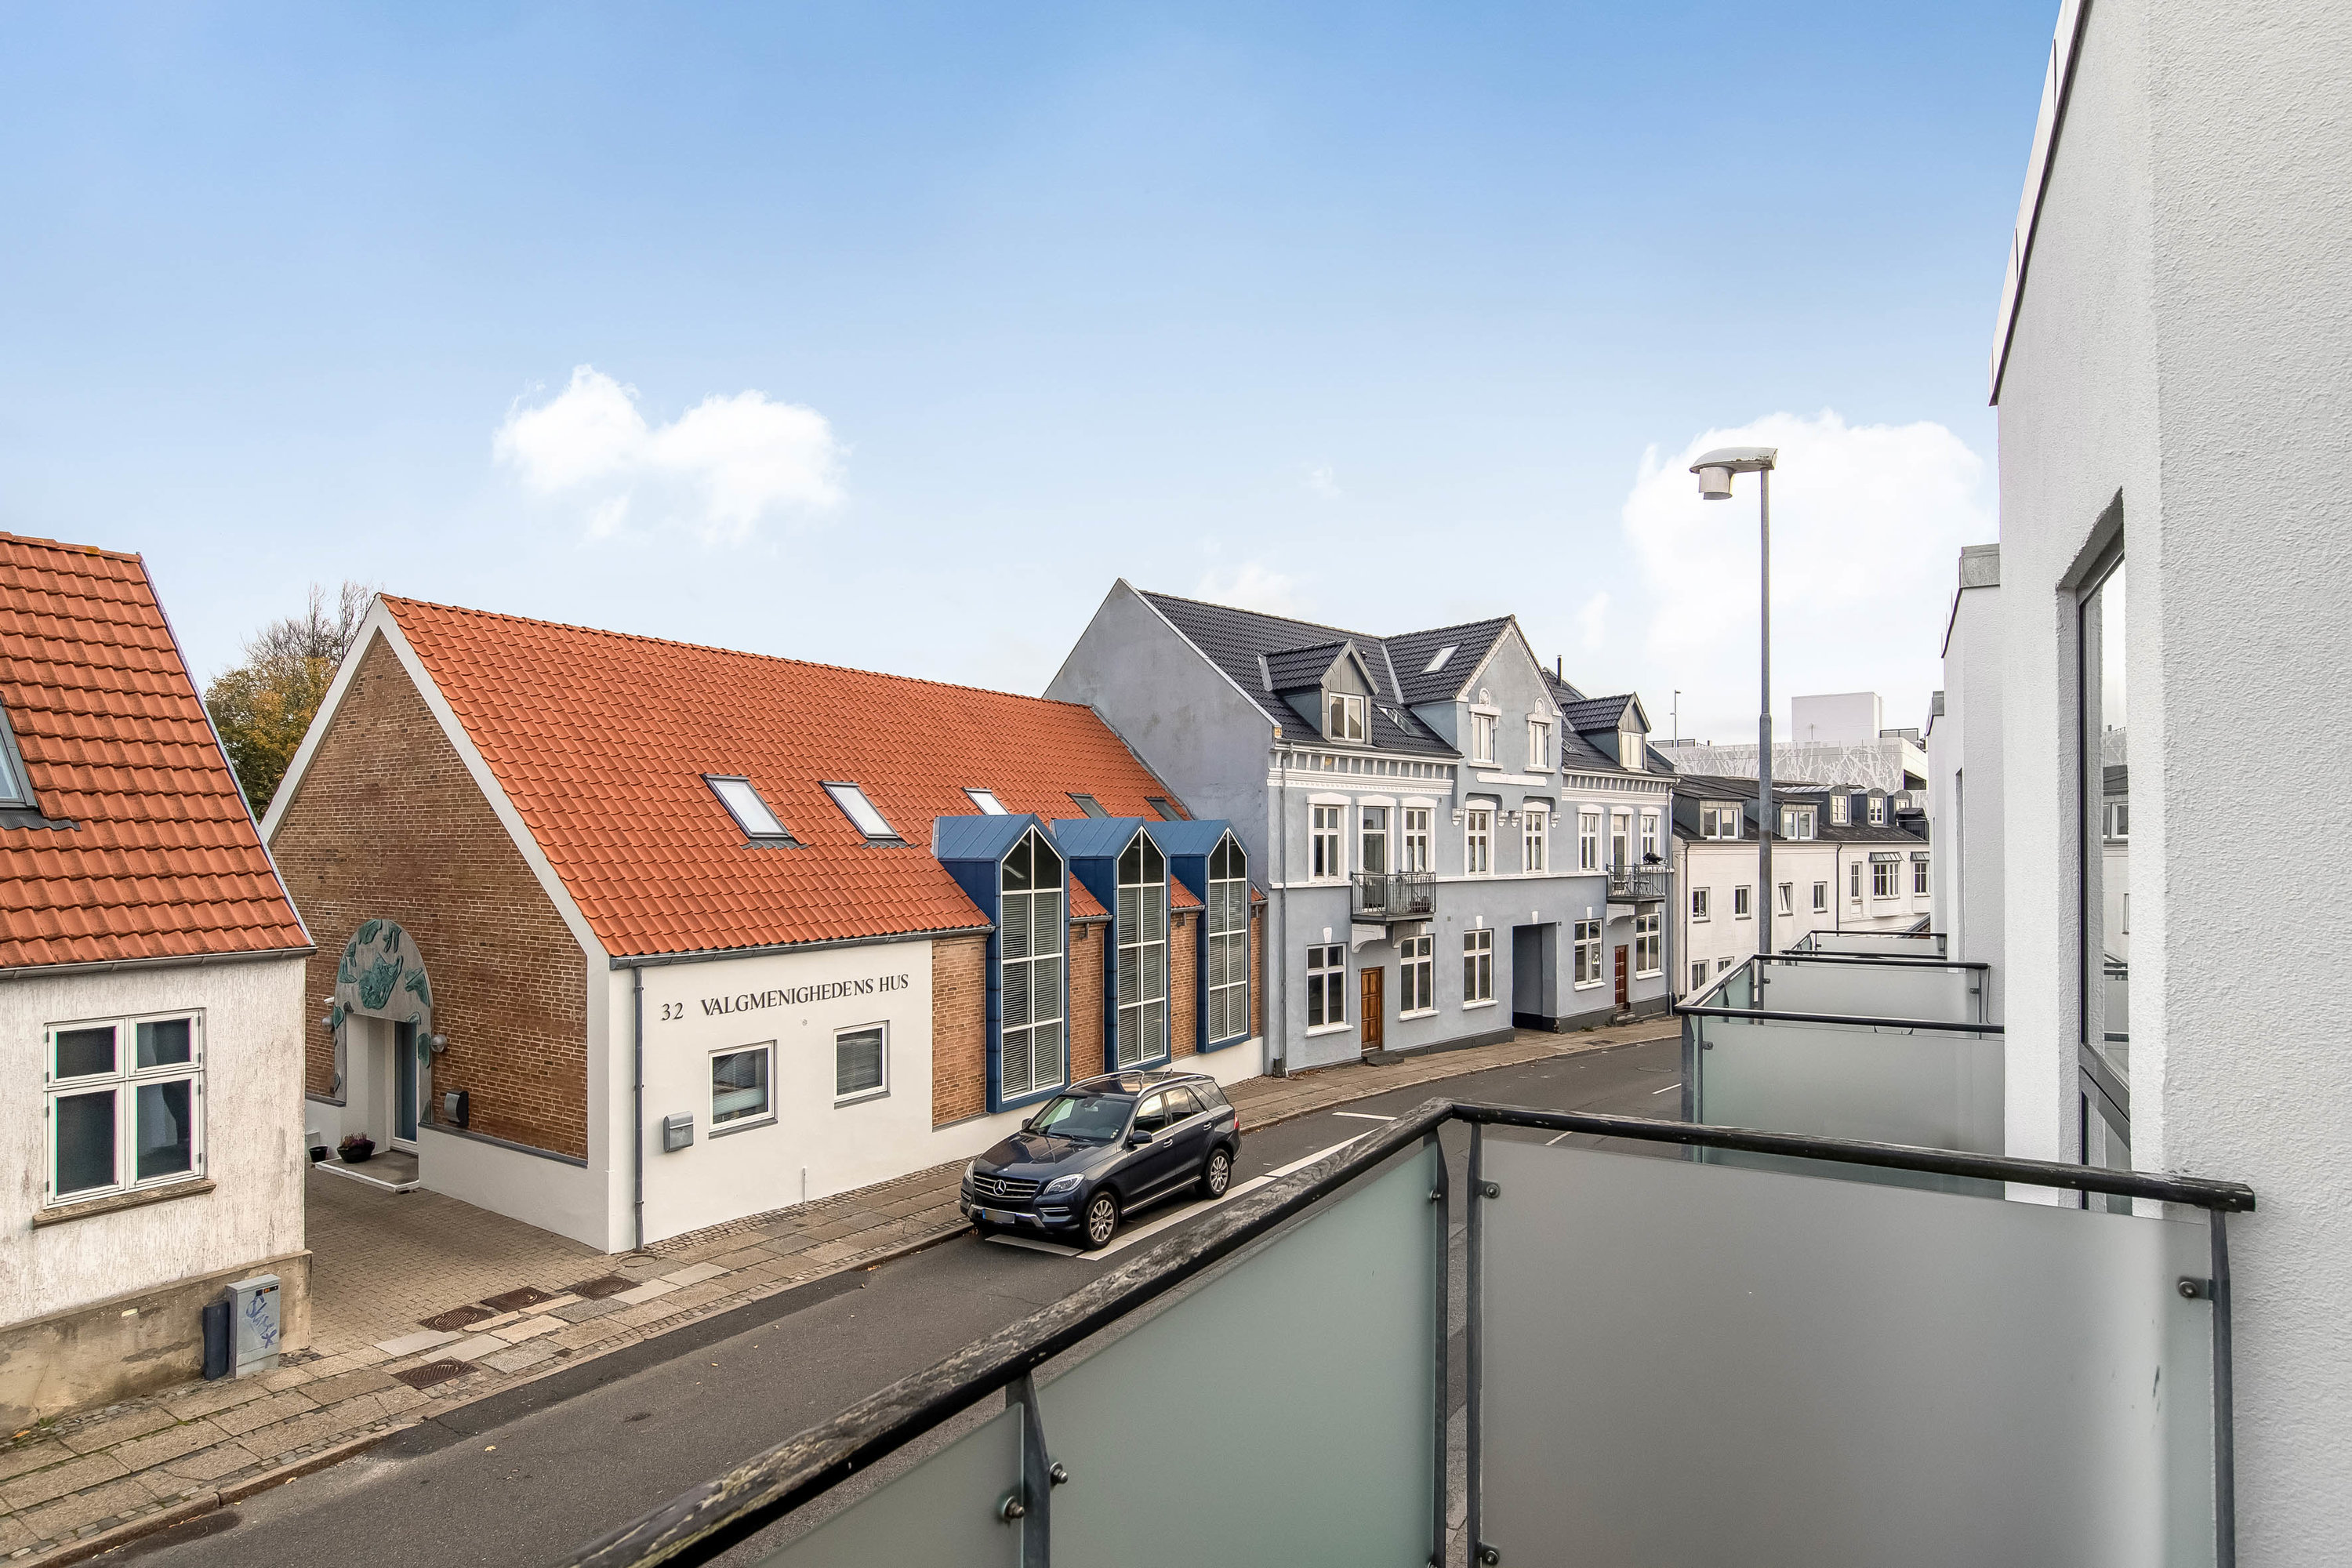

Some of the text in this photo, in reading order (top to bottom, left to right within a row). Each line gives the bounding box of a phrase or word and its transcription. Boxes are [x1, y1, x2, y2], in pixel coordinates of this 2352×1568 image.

[661, 974, 909, 1021] 32 VALGMENIGHEDENS HUS
